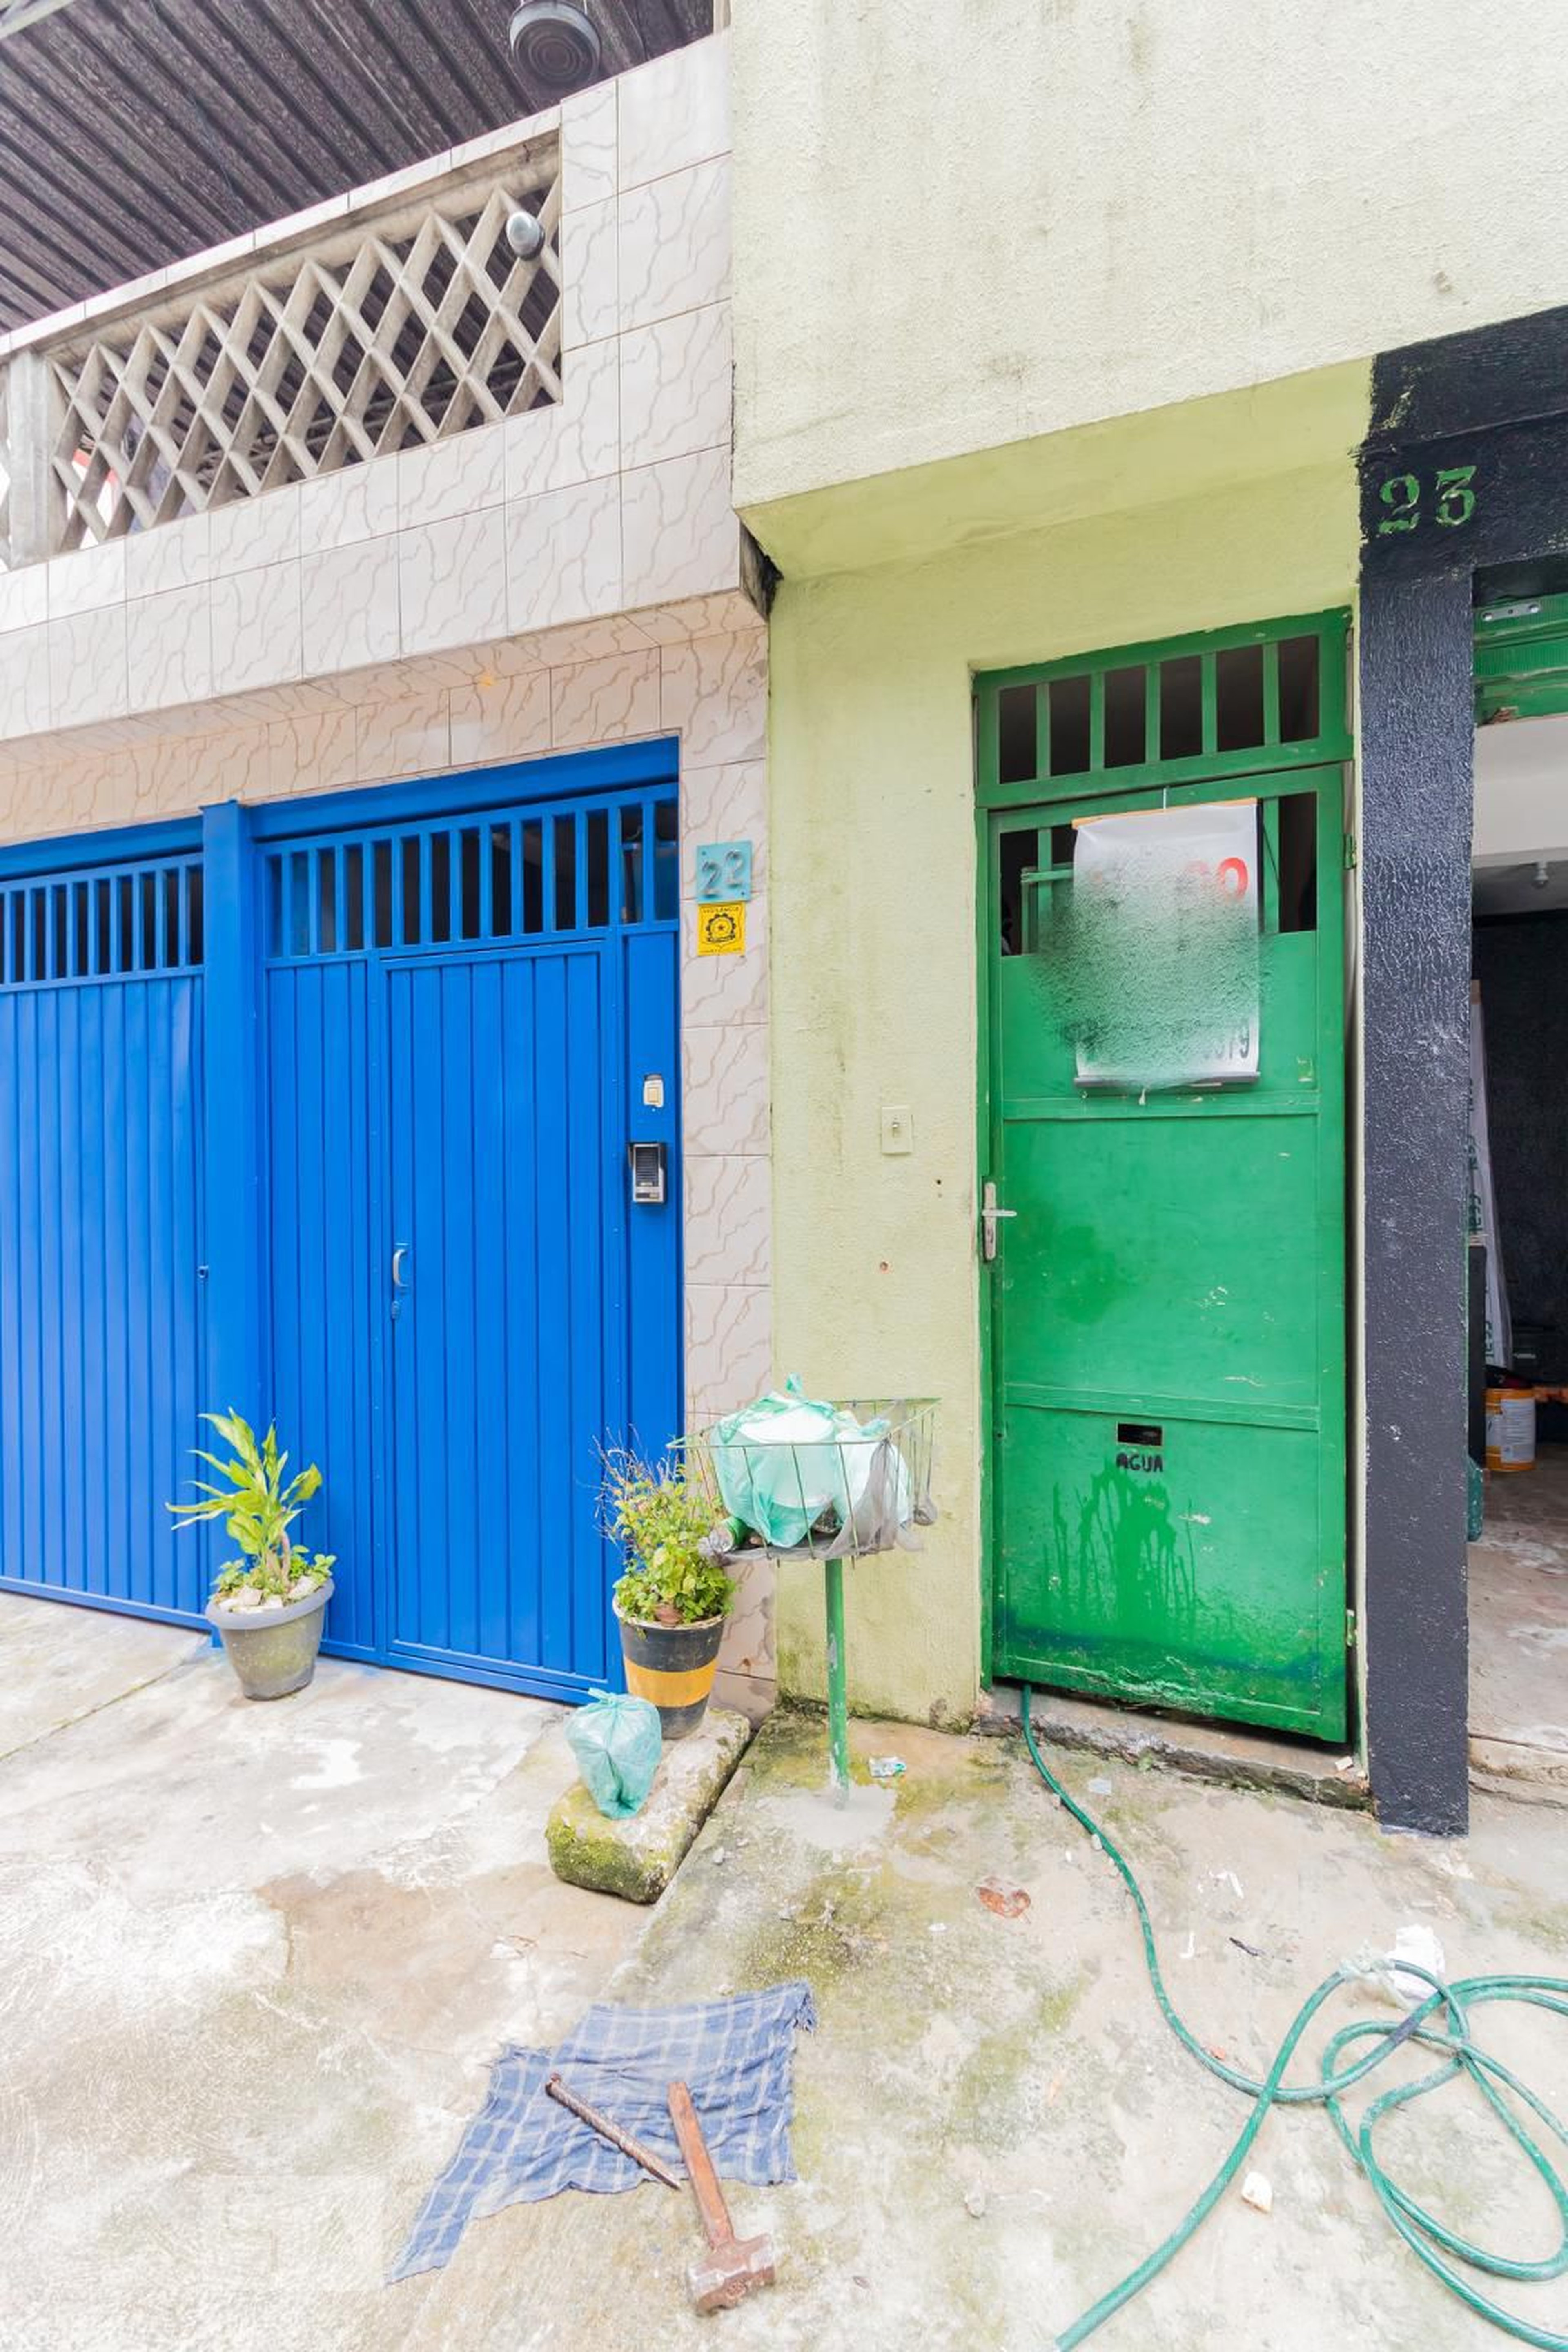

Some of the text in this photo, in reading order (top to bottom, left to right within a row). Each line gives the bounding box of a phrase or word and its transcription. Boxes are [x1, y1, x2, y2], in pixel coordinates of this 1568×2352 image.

[1379, 465, 1476, 534] 23
[700, 849, 744, 898] 22
[1116, 1452, 1163, 1472] AGUA
